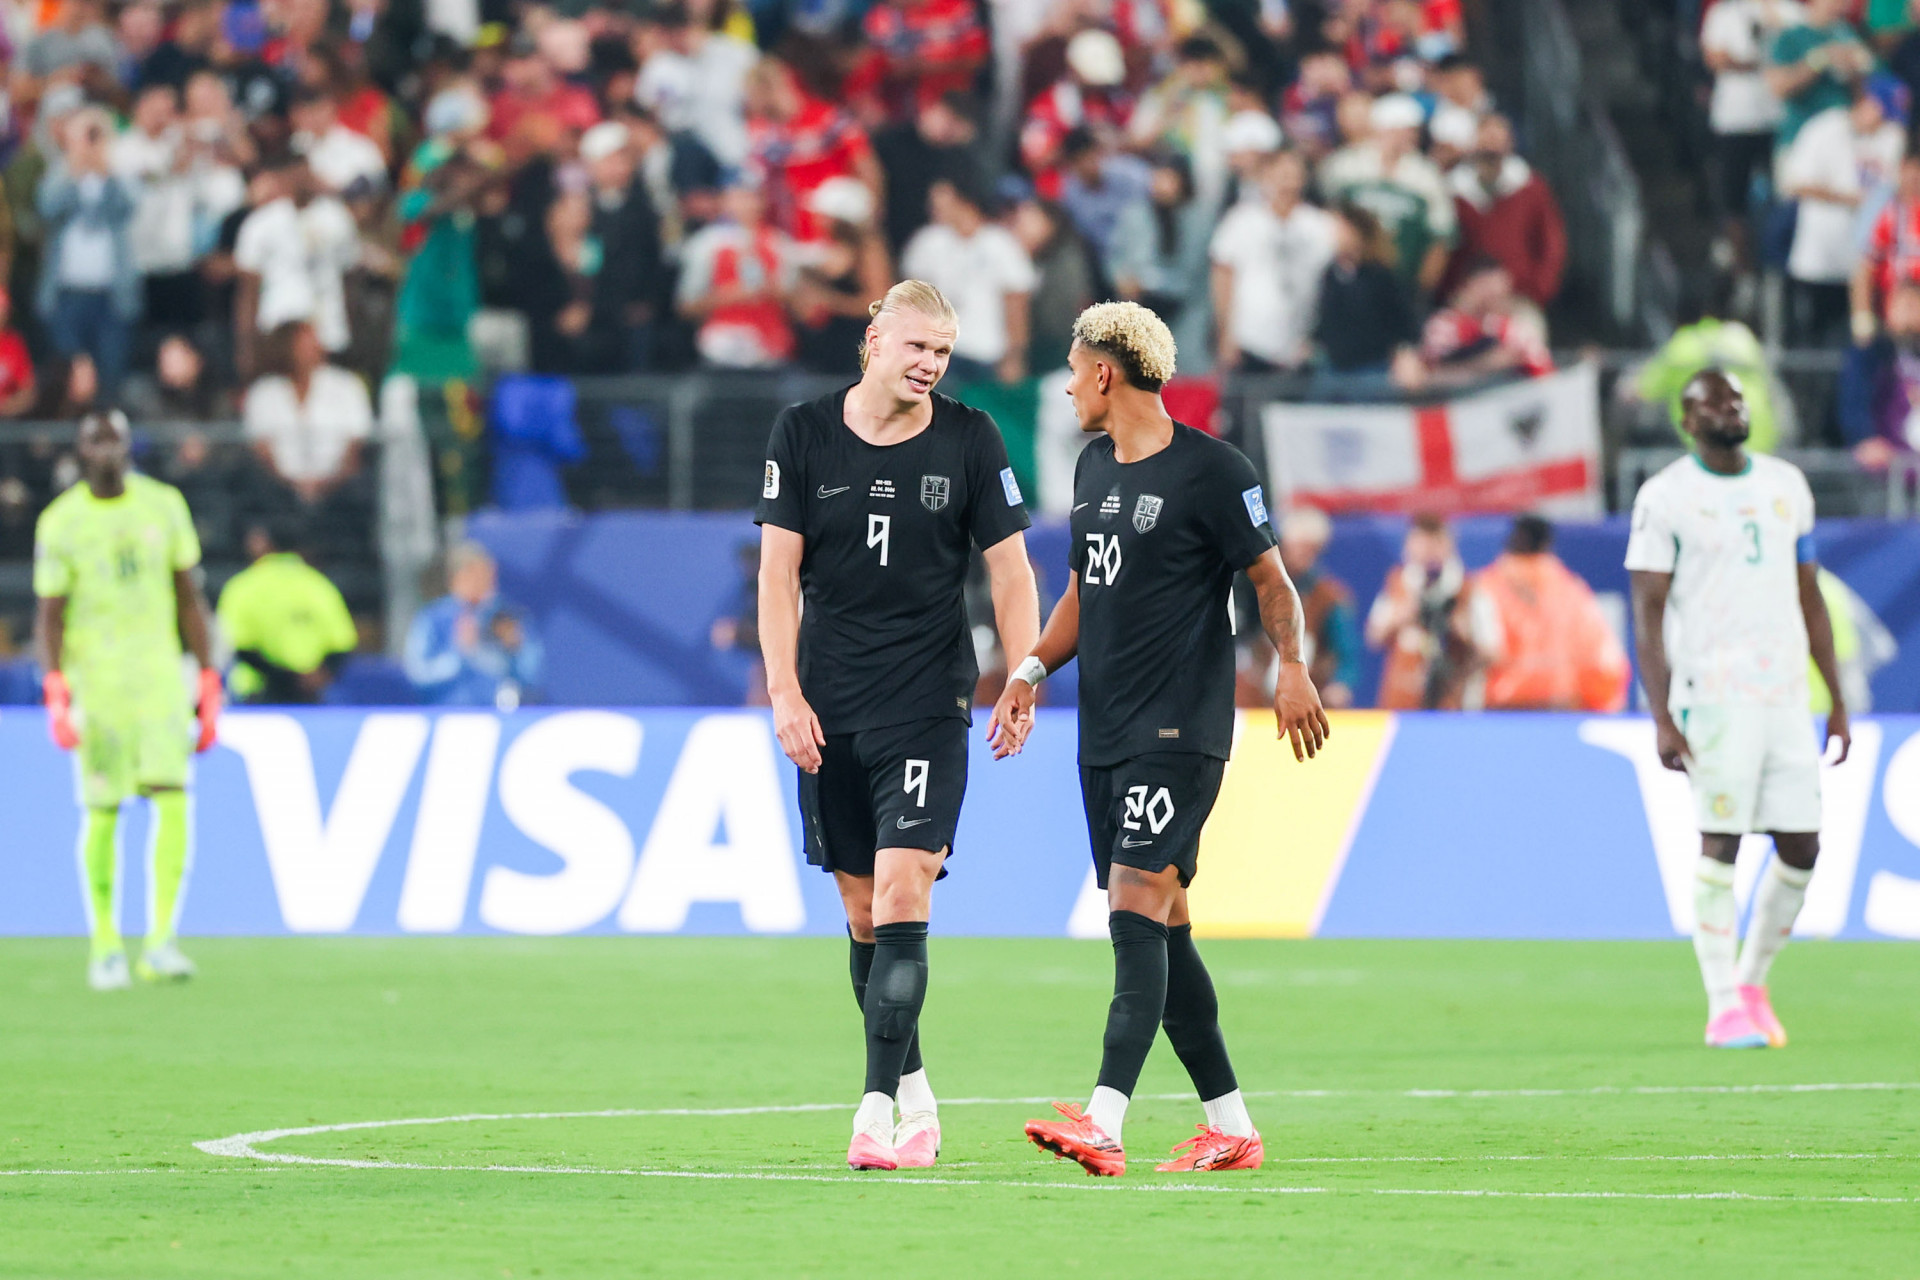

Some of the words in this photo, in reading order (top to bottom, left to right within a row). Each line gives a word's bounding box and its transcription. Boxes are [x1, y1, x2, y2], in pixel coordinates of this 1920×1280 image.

[866, 513, 891, 567] 9
[1085, 532, 1122, 586] 20
[1743, 521, 1762, 564] 3
[903, 758, 930, 808] 9
[217, 711, 807, 935] VISA
[1122, 784, 1175, 835] 20
